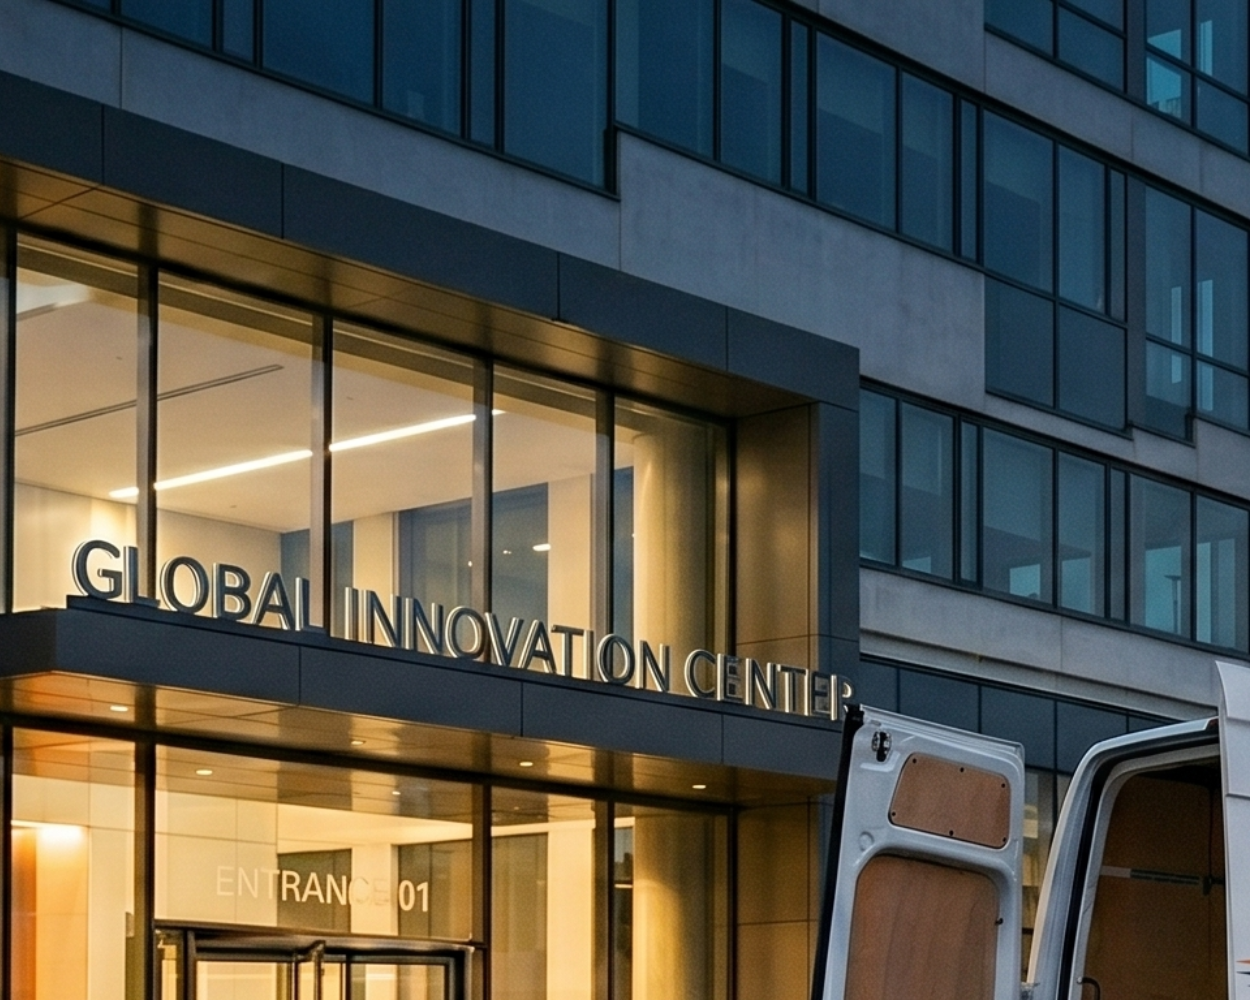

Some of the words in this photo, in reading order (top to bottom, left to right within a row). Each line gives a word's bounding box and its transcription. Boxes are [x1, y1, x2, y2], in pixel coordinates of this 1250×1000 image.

[71, 540, 324, 631] GLOBAL
[344, 587, 670, 692] INNOVATION
[216, 866, 391, 906] ENTRANCE
[399, 880, 429, 912] 01
